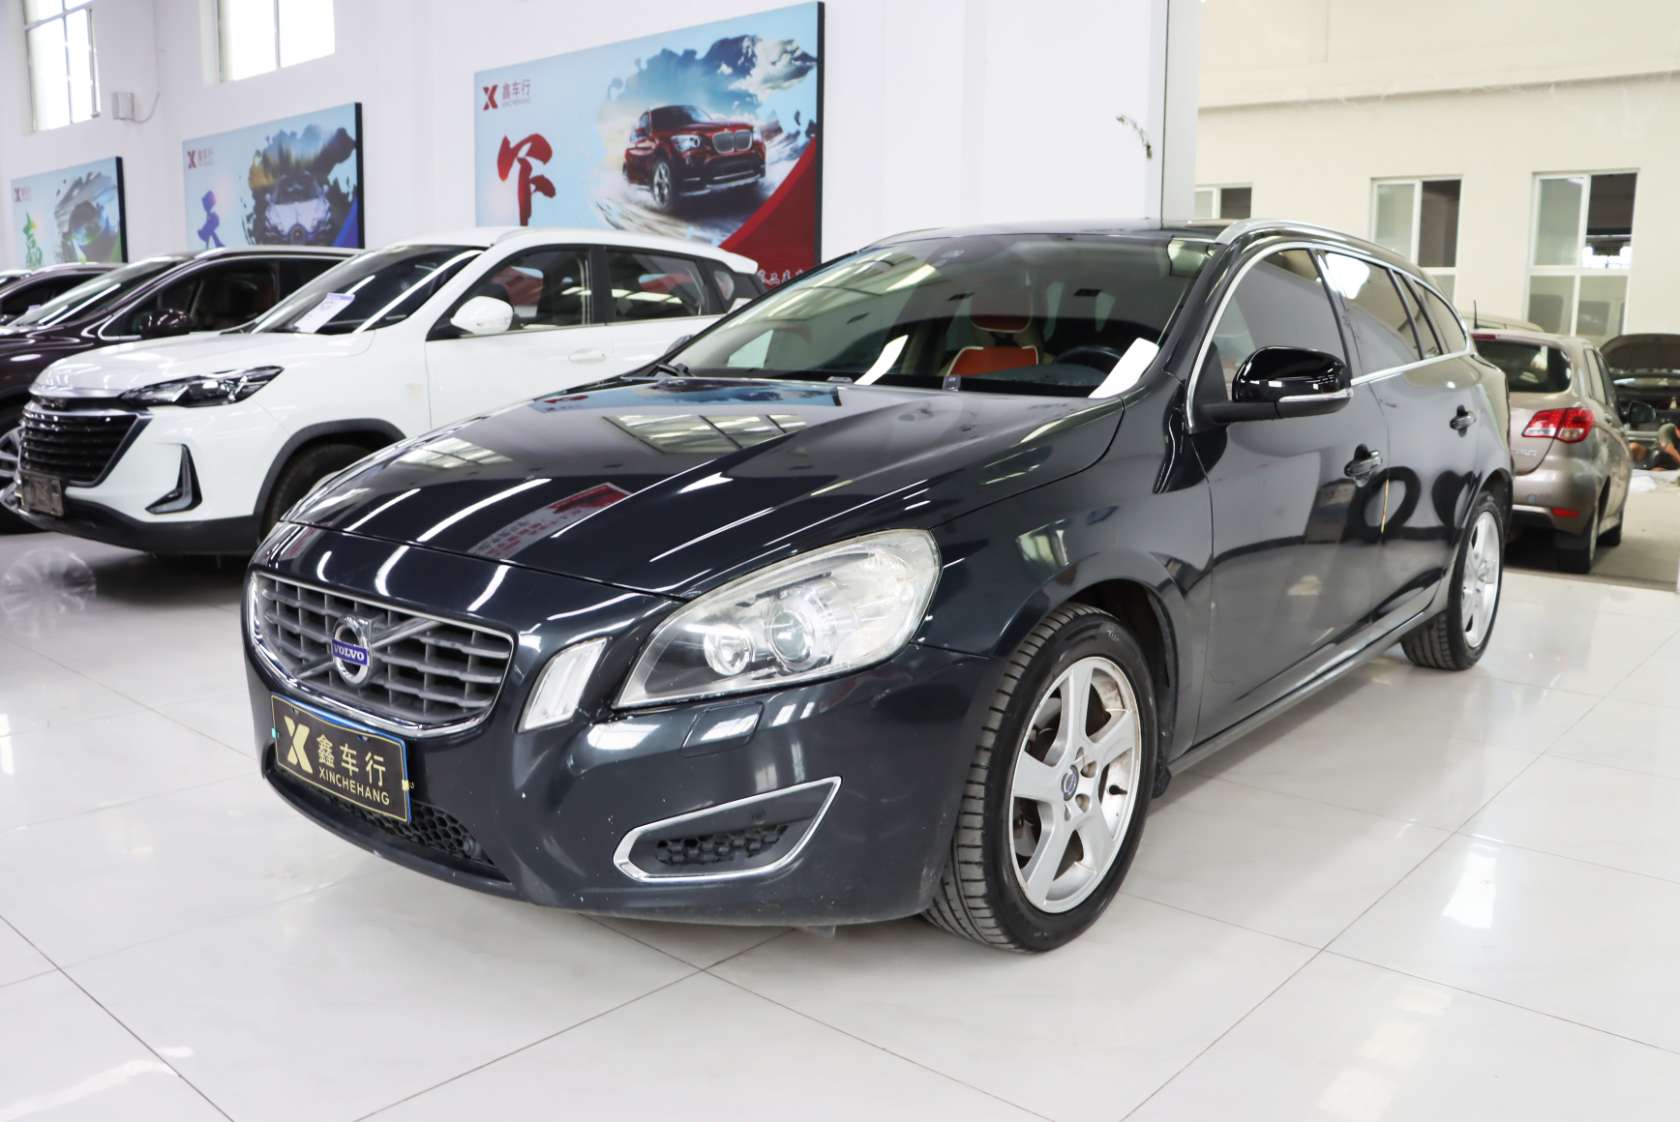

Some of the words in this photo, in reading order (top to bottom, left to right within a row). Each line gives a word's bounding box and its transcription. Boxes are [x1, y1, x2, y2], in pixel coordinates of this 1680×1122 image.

[333, 643, 365, 661] VOLVO
[316, 733, 386, 788] 鑫车行
[318, 766, 390, 806] XINCHEHANG
